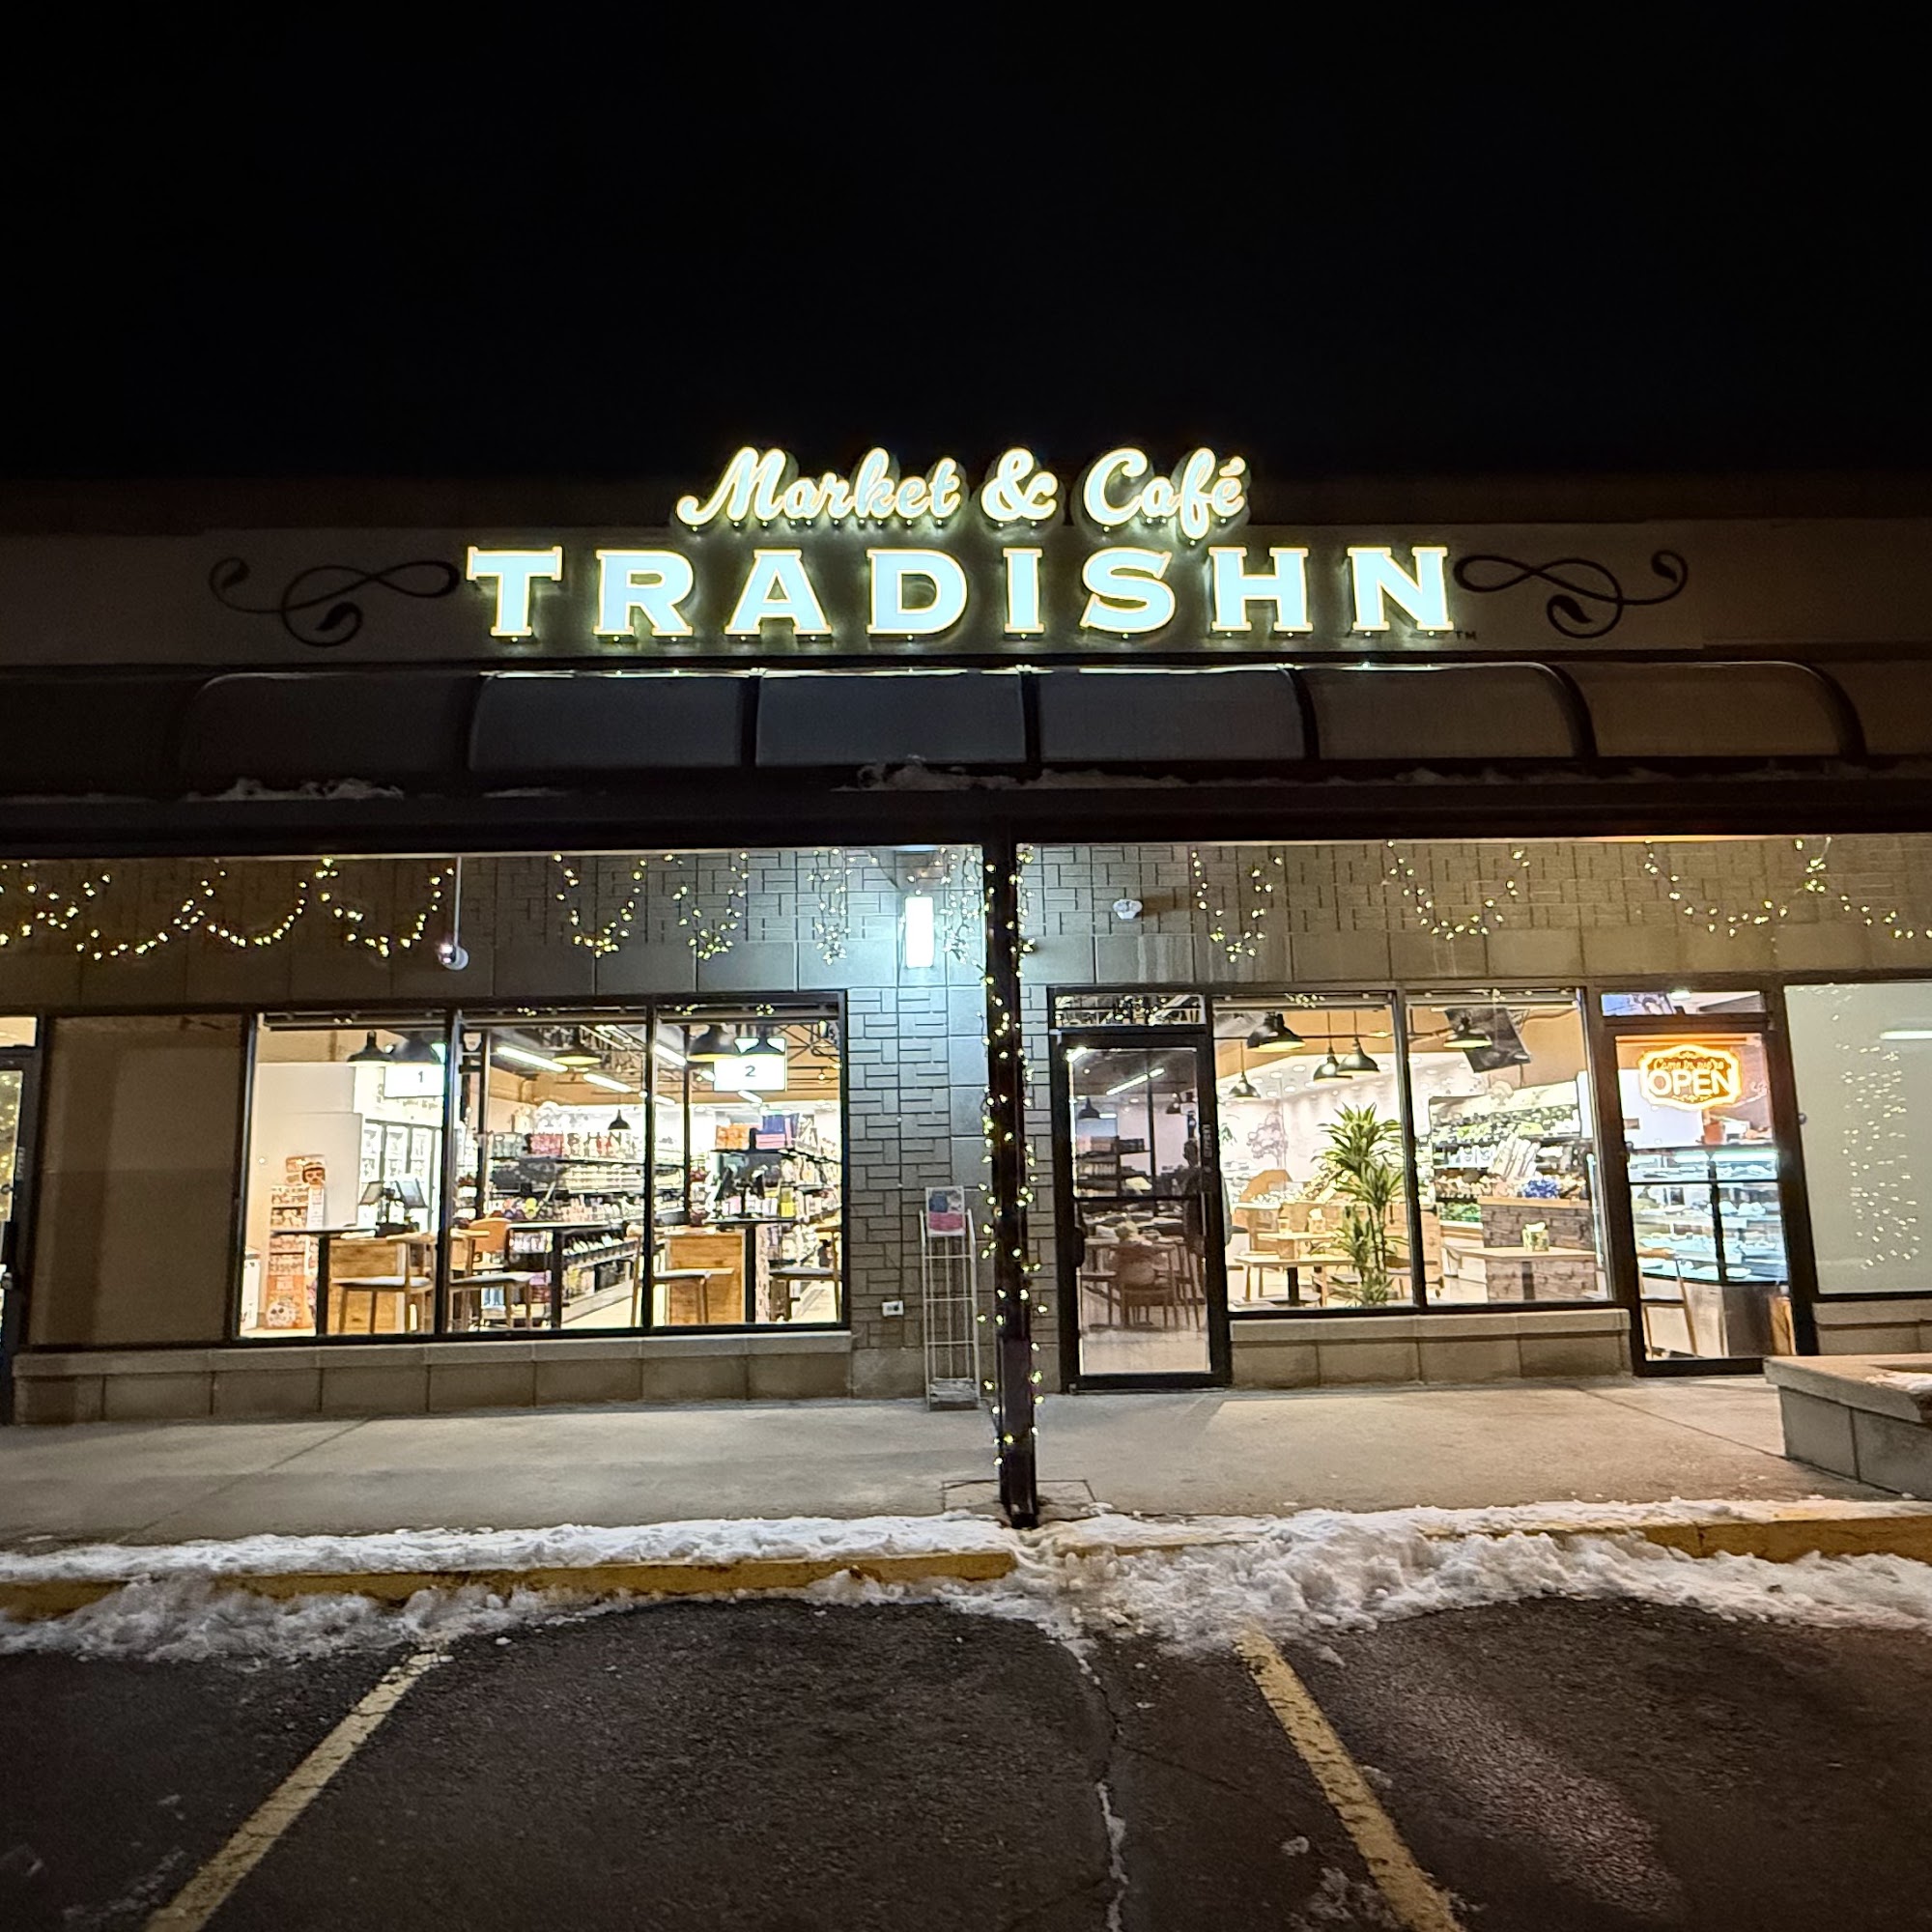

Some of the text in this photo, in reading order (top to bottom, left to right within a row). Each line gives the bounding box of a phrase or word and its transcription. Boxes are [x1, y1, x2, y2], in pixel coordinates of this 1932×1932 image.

[676, 446, 1247, 540] Market & Café
[466, 546, 1454, 637] TRADISHN
[417, 1070, 424, 1083] 1
[745, 1065, 756, 1077] 2
[1648, 1068, 1731, 1096] OPEN
